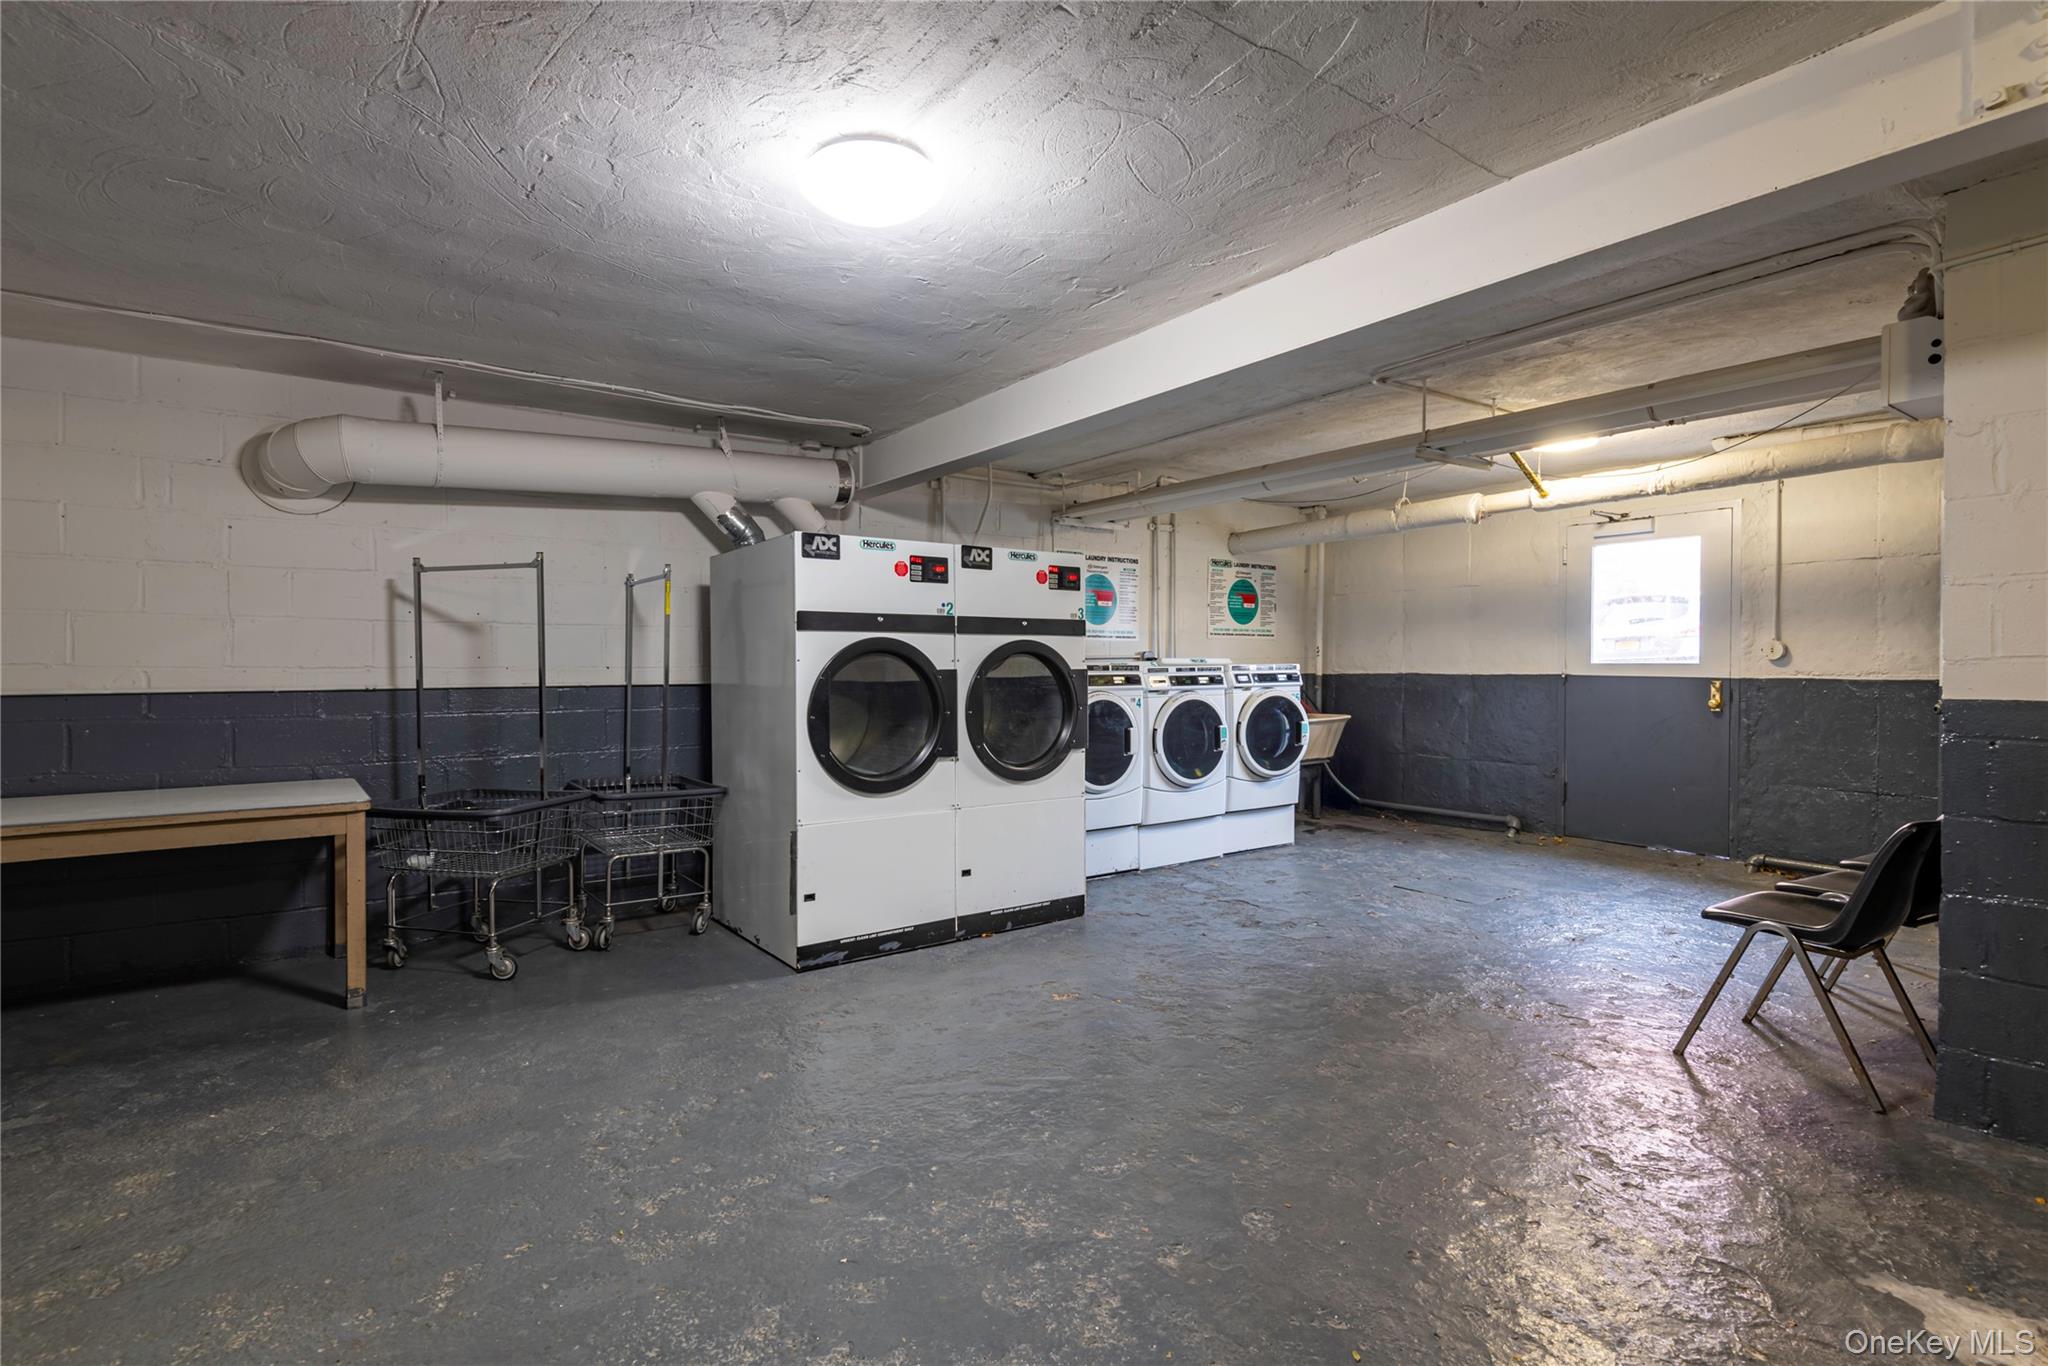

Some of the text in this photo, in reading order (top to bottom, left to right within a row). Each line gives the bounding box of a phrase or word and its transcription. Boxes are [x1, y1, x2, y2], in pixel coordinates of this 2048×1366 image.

[812, 535, 837, 551] ADC
[863, 539, 894, 550] Hercules
[969, 548, 990, 561] ADC
[1010, 551, 1036, 561] Hercules
[1085, 554, 1139, 565] LAUNDRY INSTRUCTIONS
[946, 602, 954, 615] 2
[1078, 607, 1084, 619] 3
[1135, 697, 1142, 708] 4
